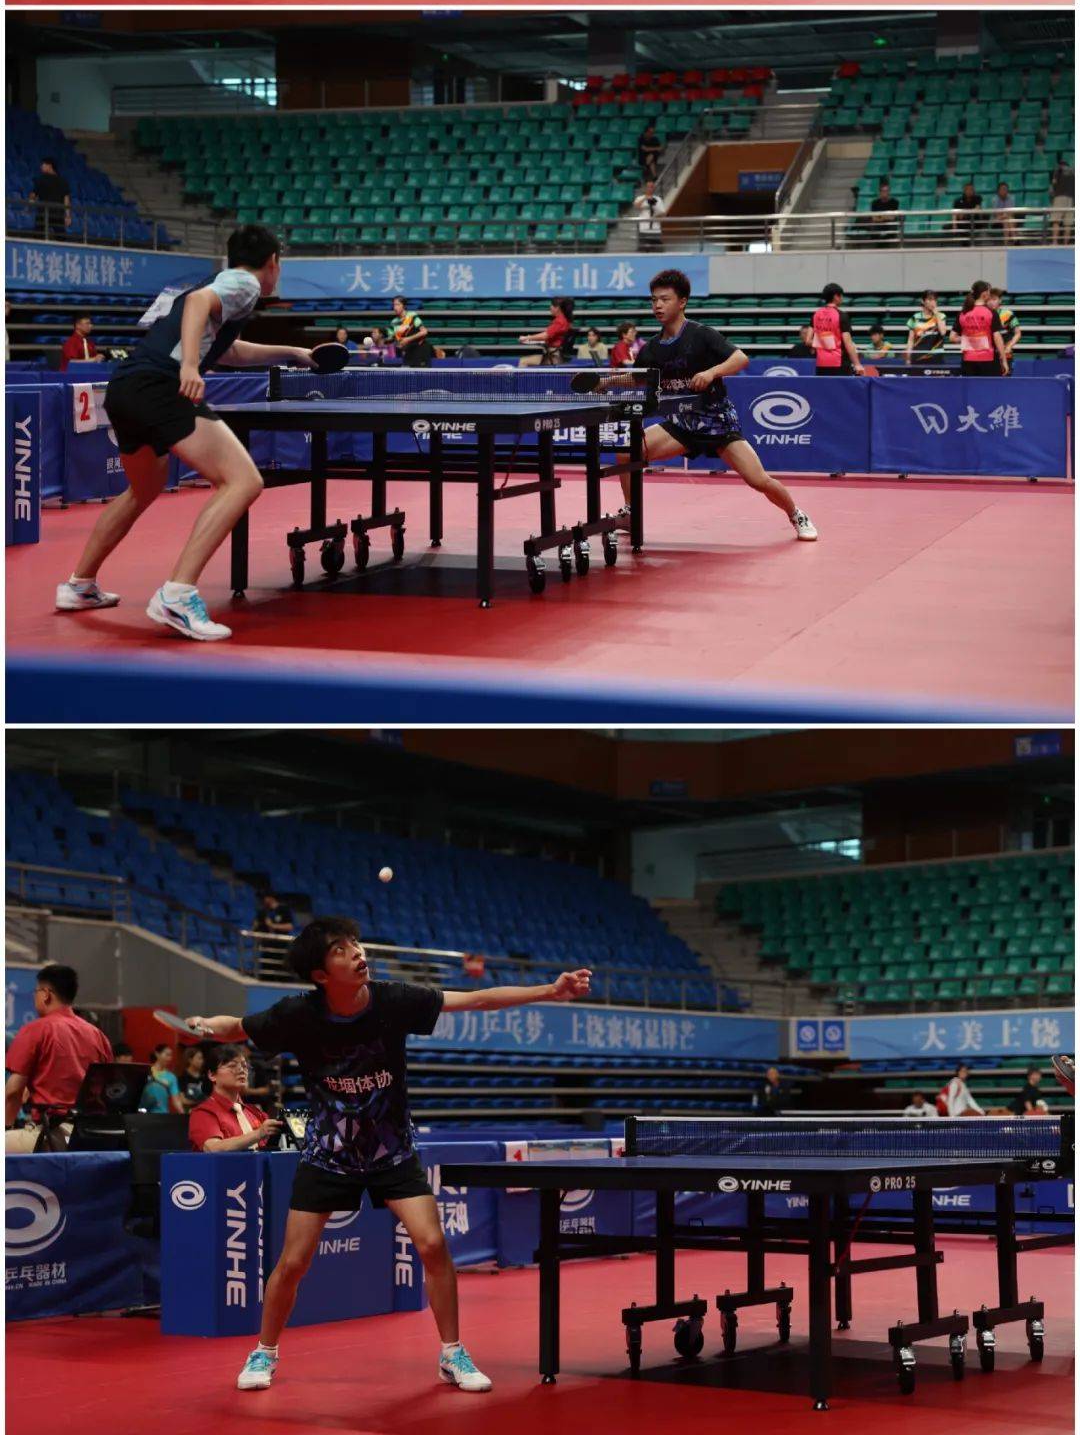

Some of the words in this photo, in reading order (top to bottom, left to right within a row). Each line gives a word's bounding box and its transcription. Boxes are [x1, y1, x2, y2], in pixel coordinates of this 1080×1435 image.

[347, 263, 474, 293] 大美上饶
[505, 262, 635, 292] 自在山水
[79, 391, 90, 421] 2
[431, 422, 477, 431] YINHE
[753, 434, 811, 445] YINHE
[15, 415, 31, 522] YINHE
[920, 1018, 1060, 1051] 大美上饶
[741, 1179, 791, 1191] YINHE
[885, 1177, 902, 1191] PRO
[905, 1176, 916, 1189] 25
[227, 1181, 246, 1308] YINHE
